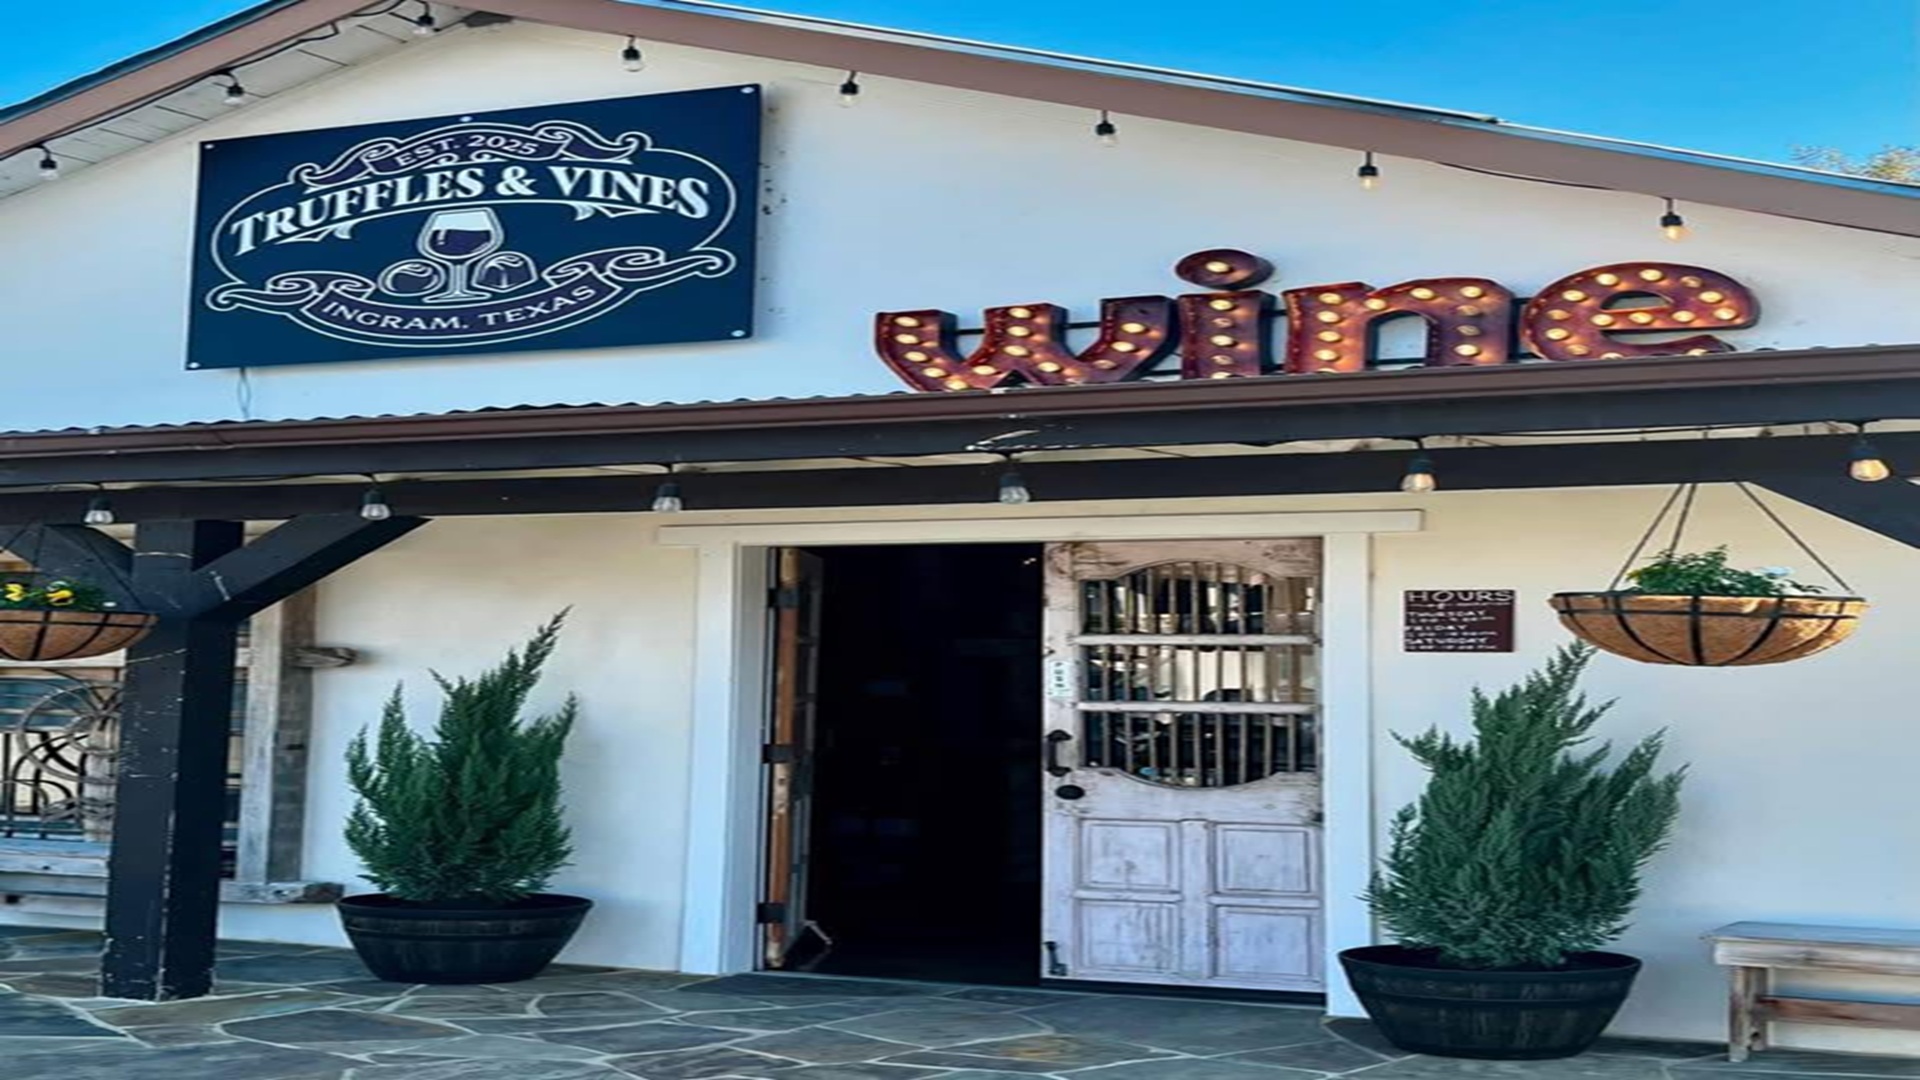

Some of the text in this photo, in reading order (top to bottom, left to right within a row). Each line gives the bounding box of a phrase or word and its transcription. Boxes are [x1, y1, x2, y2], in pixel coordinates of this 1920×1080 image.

[395, 134, 539, 167] EST. 2025
[229, 165, 711, 256] TRUFFLES & VINES
[479, 285, 597, 327] TEXAS
[874, 248, 1763, 394] wine
[1407, 590, 1514, 602] HOURS
